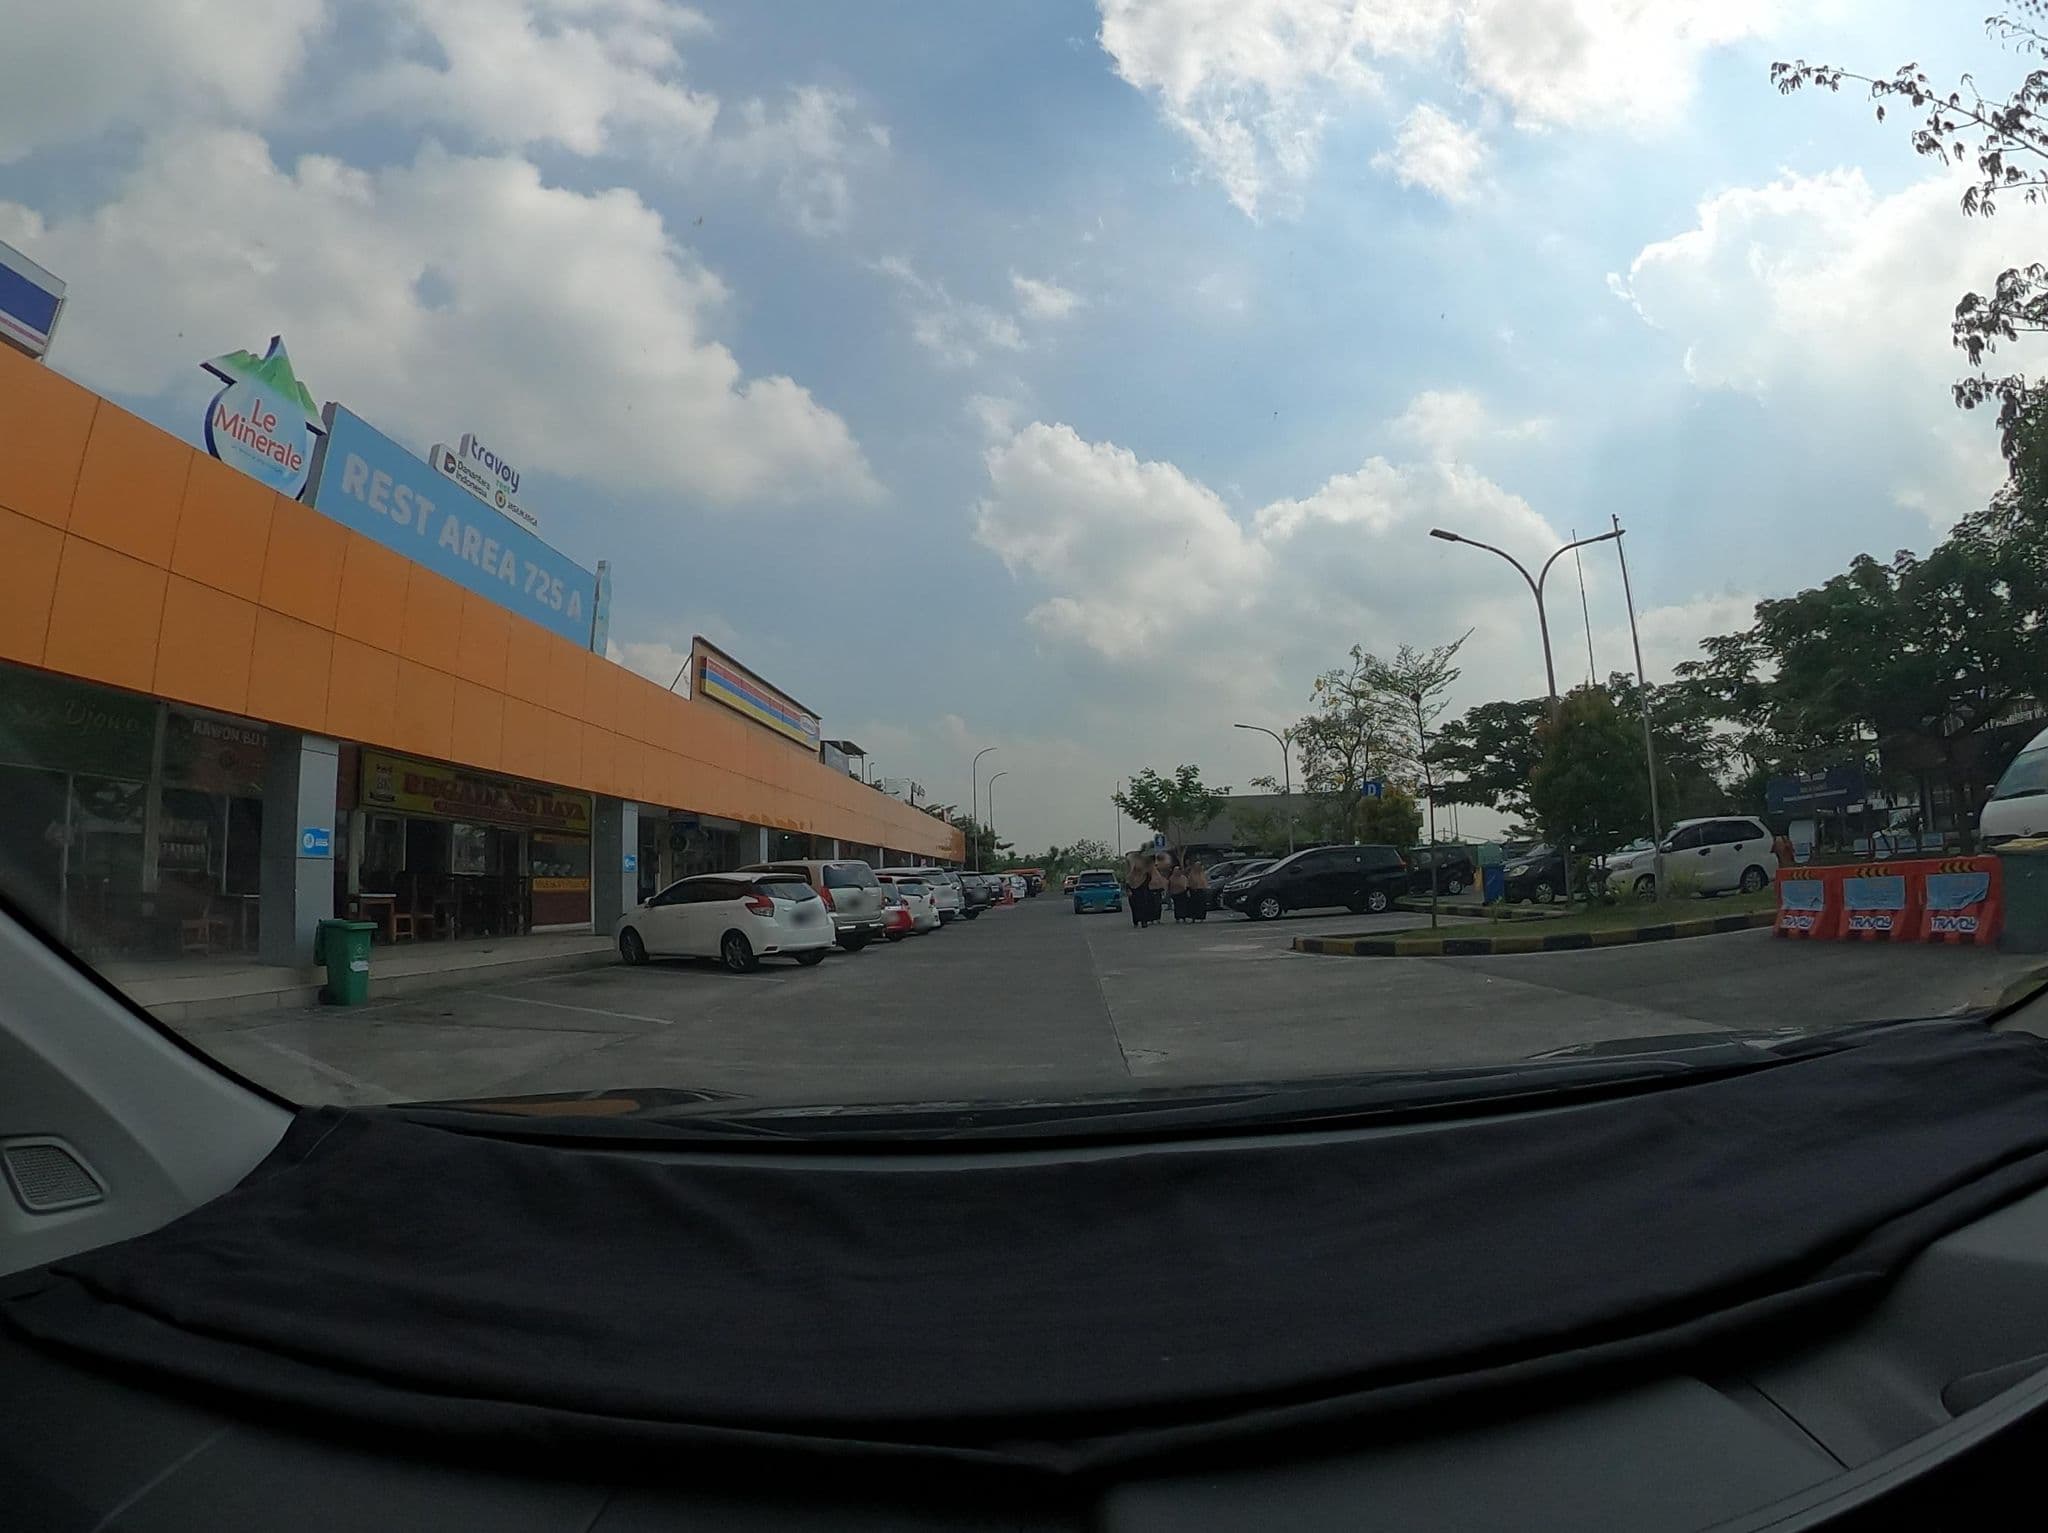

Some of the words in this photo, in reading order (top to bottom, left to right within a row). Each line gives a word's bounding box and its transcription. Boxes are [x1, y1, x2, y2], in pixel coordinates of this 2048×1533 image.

[214, 404, 302, 471] Minerale
[251, 399, 277, 433] Le
[471, 434, 520, 493] travoy
[342, 453, 436, 537] REST
[438, 514, 516, 586] AREA
[522, 561, 564, 611] 725
[566, 588, 583, 622] A
